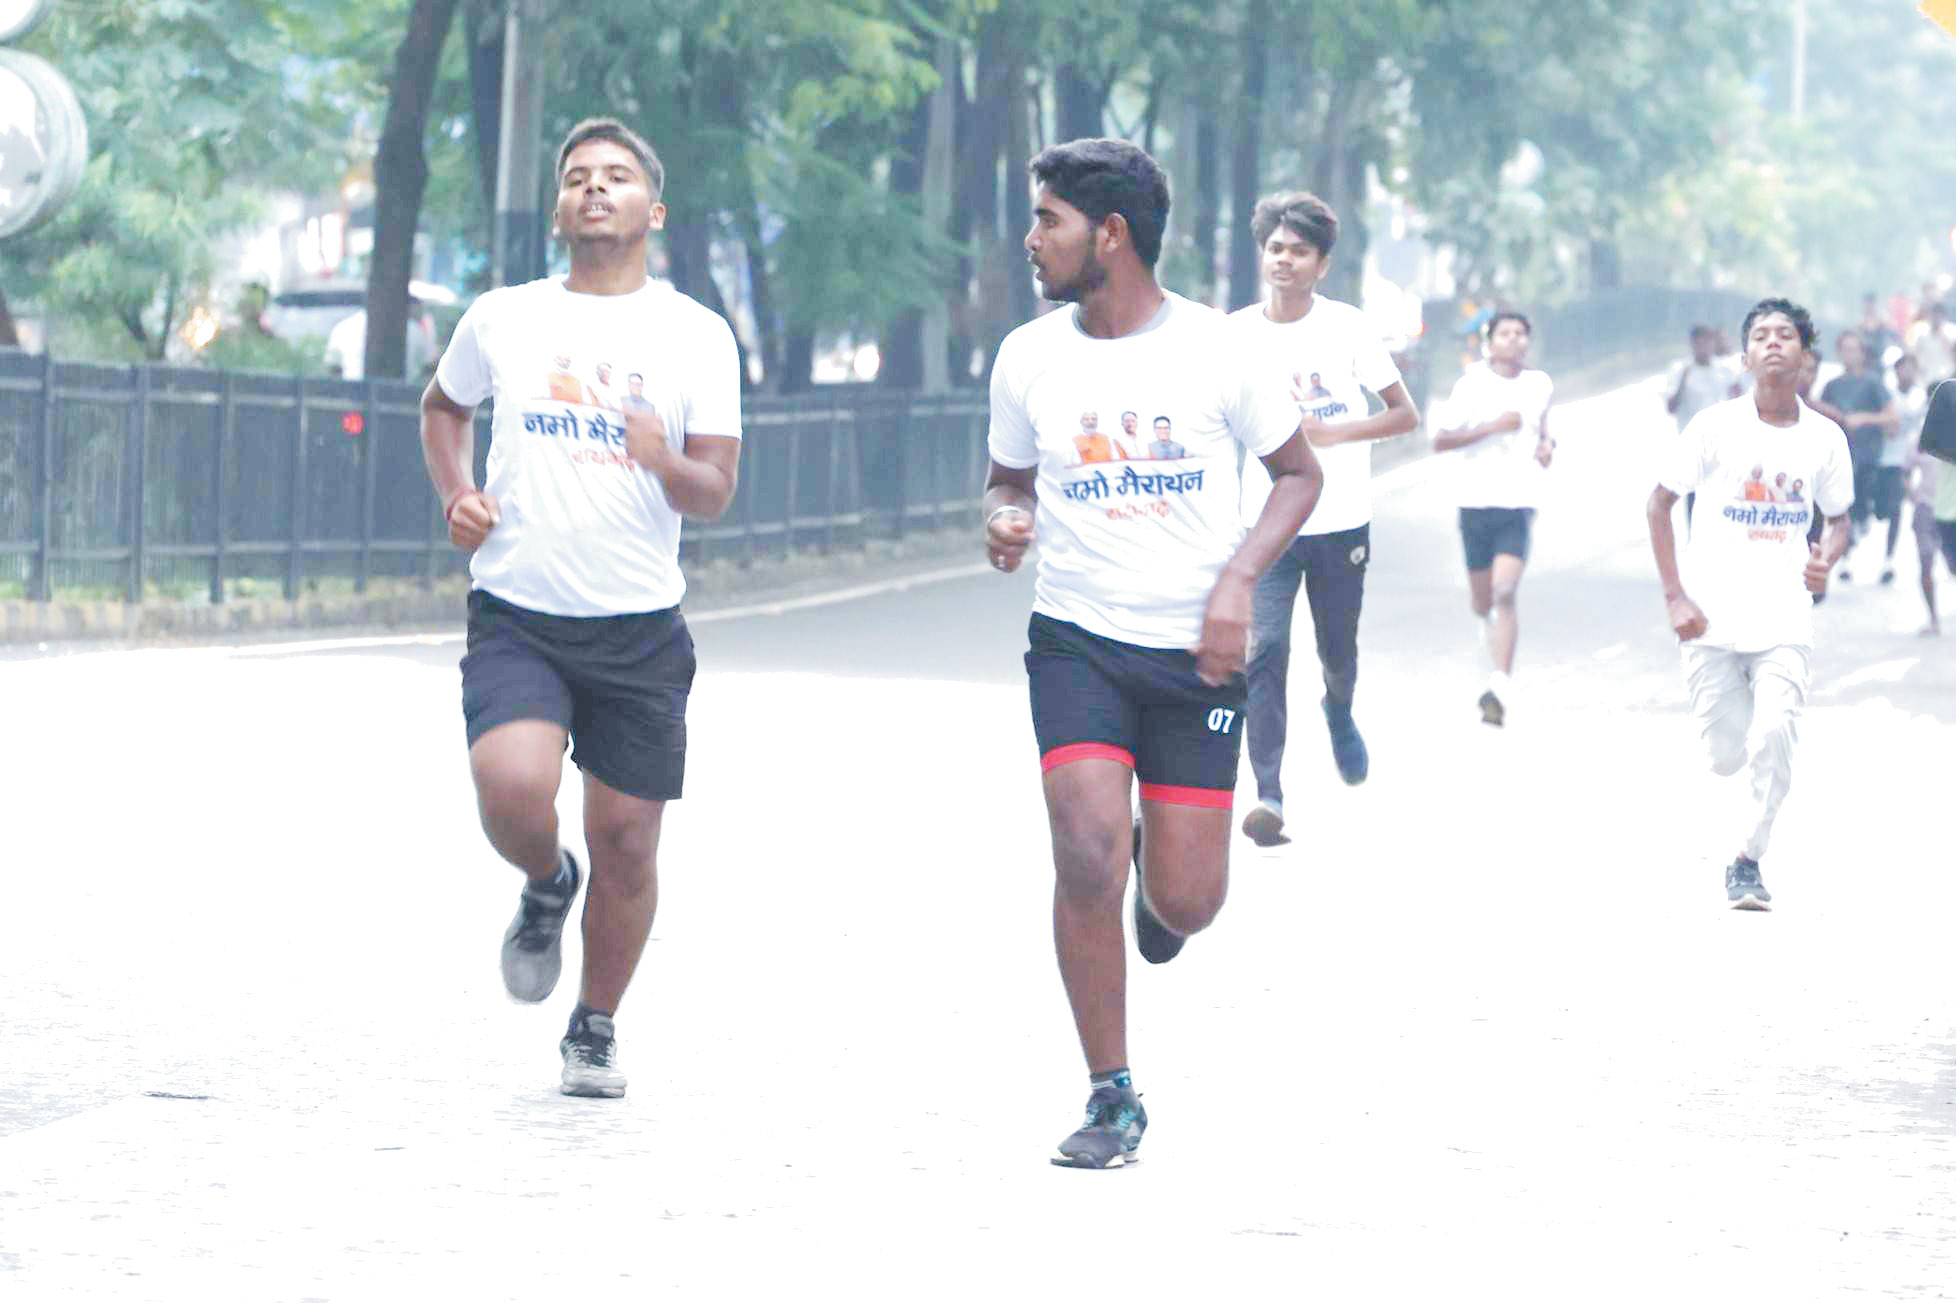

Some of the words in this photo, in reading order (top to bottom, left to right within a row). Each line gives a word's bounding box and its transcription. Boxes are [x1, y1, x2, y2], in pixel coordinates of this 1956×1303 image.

[521, 409, 579, 440] नमो
[1061, 470, 1110, 501] नमो
[1115, 465, 1205, 496] मैराथन
[1723, 505, 1758, 525] नमो
[1208, 707, 1235, 733] 07
